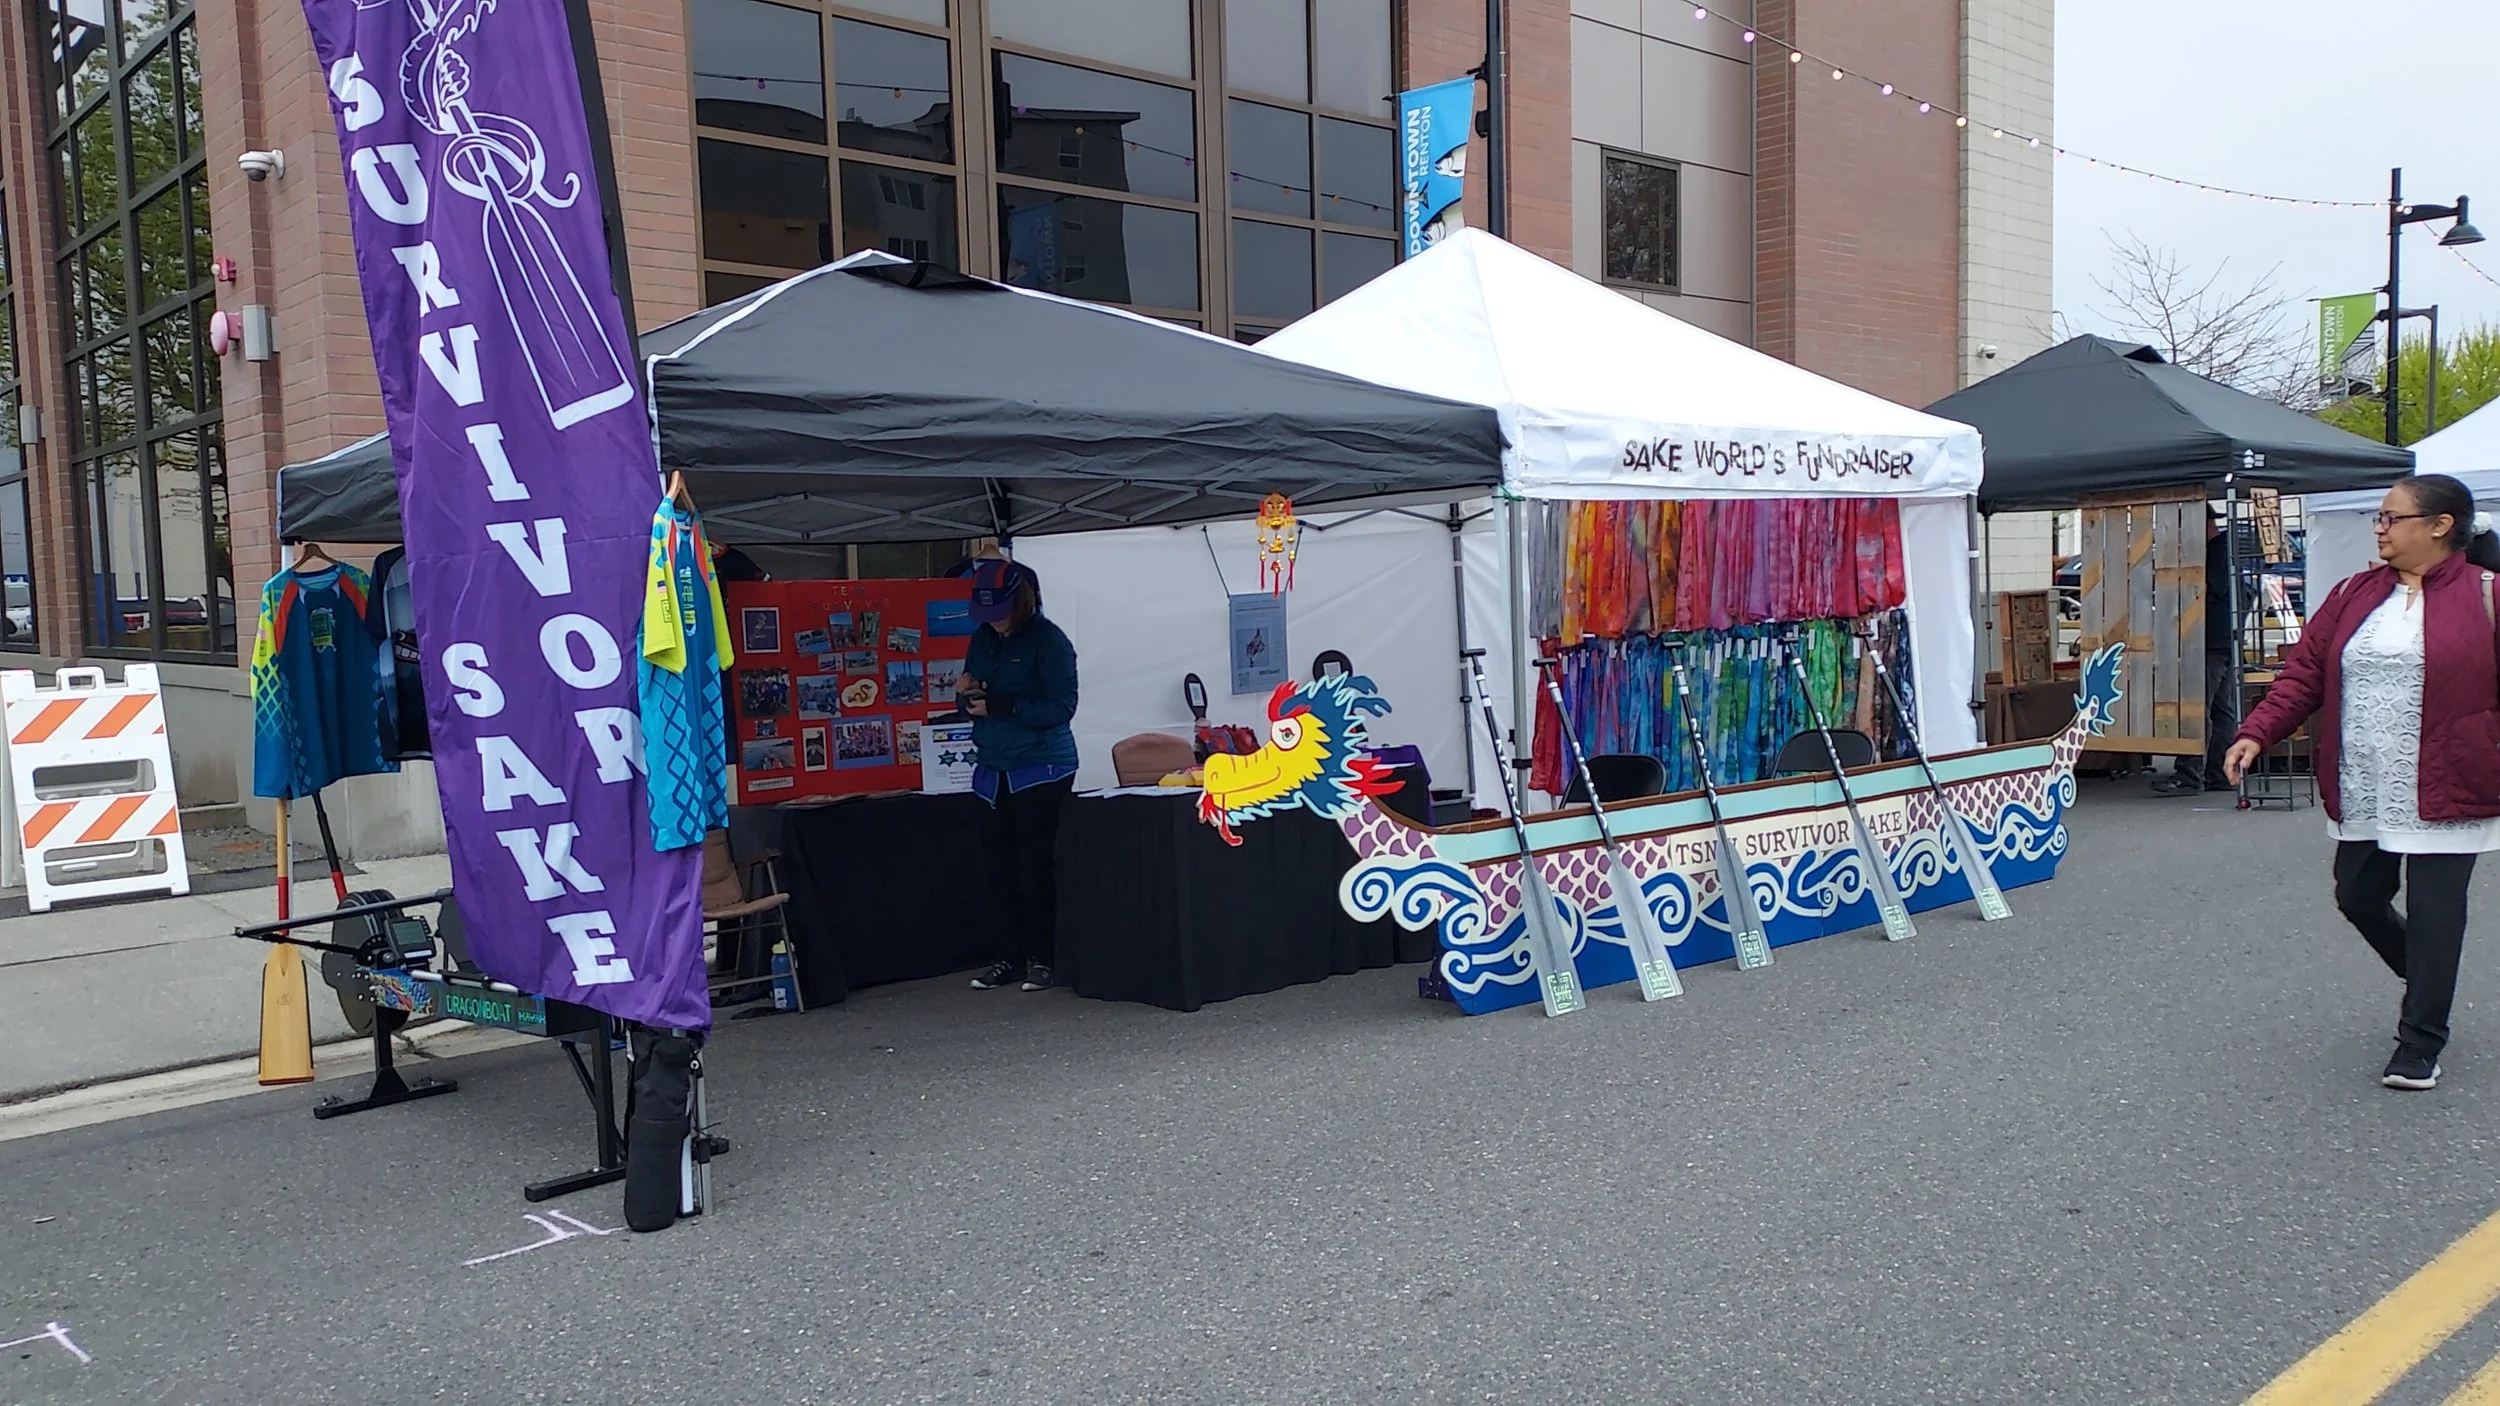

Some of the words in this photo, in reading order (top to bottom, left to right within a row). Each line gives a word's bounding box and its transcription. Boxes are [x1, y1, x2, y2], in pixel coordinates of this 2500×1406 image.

[1419, 105, 1432, 177] RENTON
[1407, 107, 1422, 256] DOWNTOWN
[2324, 305, 2336, 384] DOWNTOWN
[329, 52, 648, 785] SURVIVOR
[1622, 436, 1683, 473] SAKE
[1693, 440, 1787, 477] WORLD'S
[1796, 440, 1915, 482] FUNDRAISER
[441, 641, 635, 986] SAKE
[1745, 819, 1851, 857] SURVIVOR
[1861, 810, 1903, 837] AKE
[445, 994, 513, 1023] DRAGONBOAT
